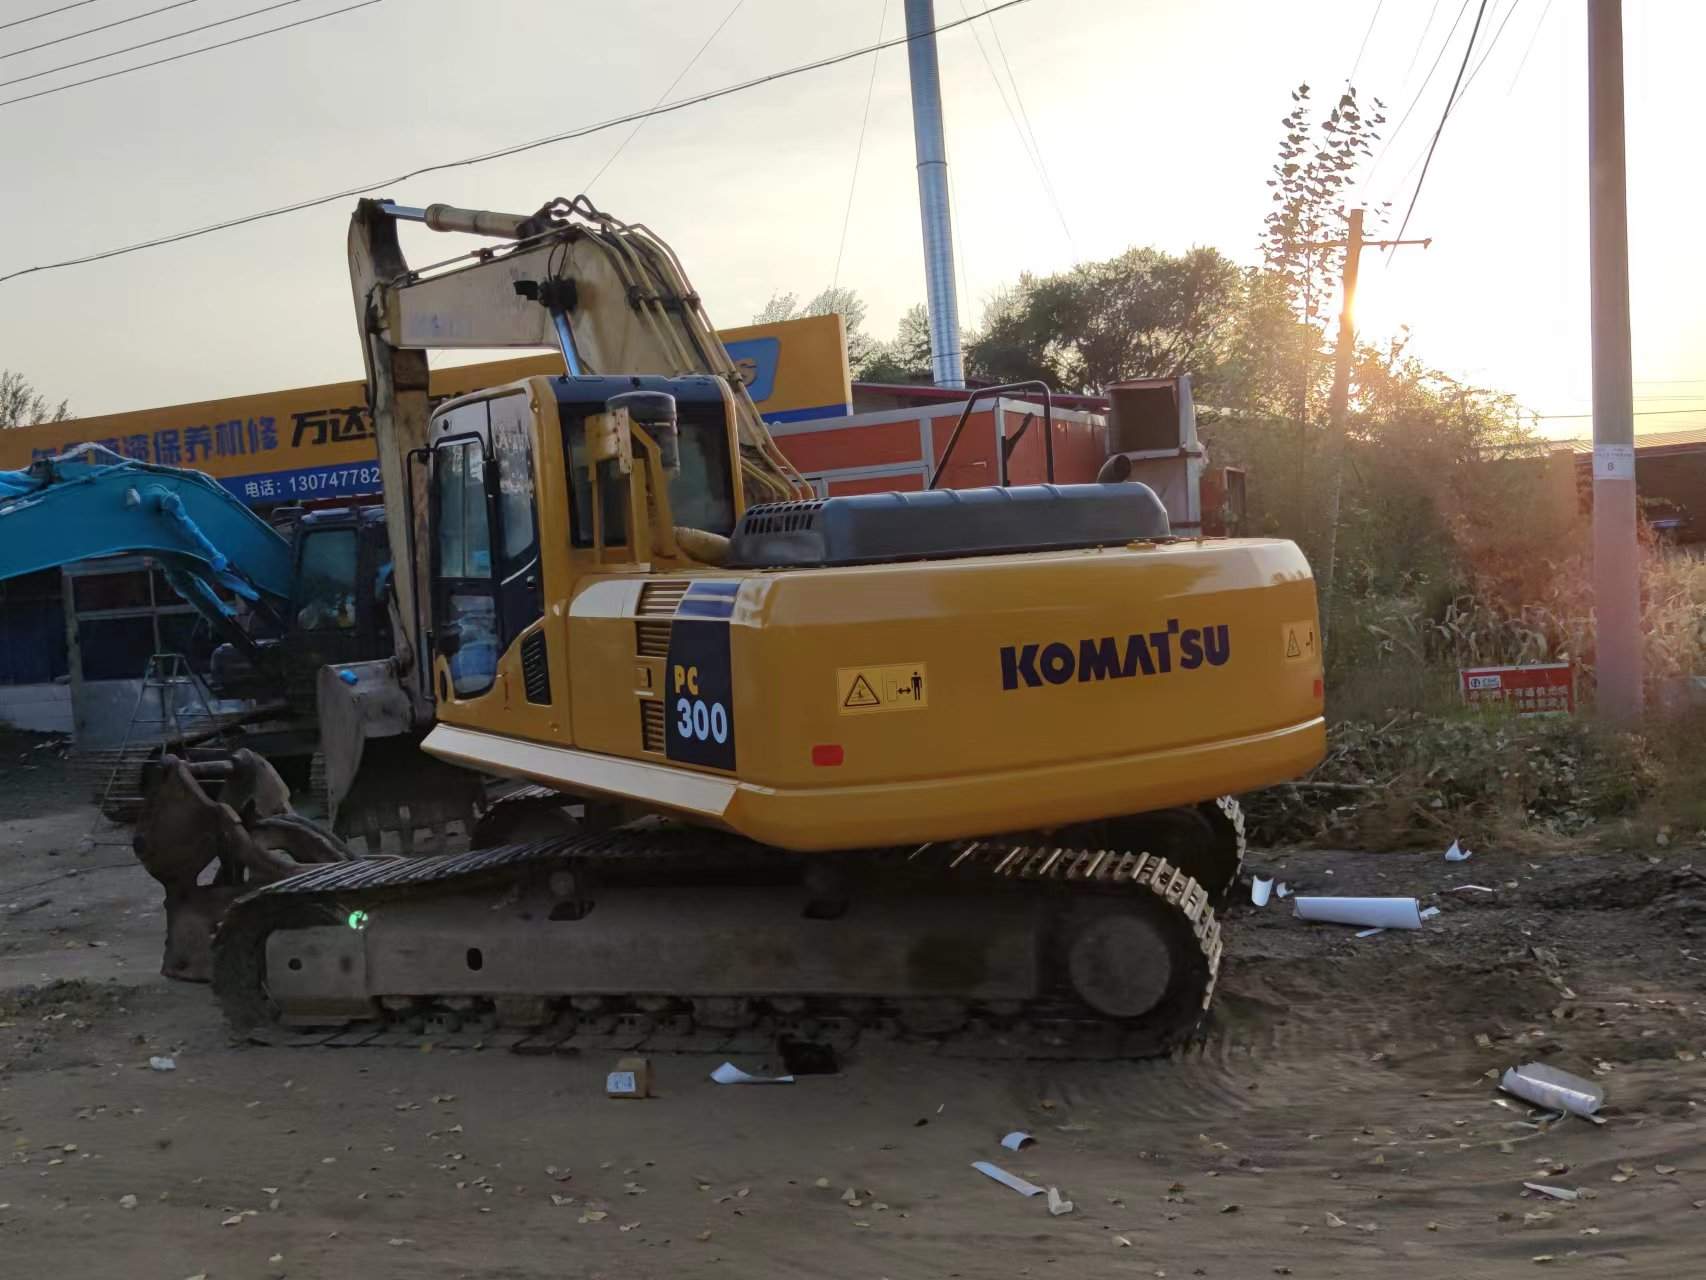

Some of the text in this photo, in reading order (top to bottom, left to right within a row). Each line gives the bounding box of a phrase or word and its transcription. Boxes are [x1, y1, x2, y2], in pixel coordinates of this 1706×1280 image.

[292, 406, 376, 447] 万达
[1000, 619, 1230, 691] KOMATSU
[673, 664, 699, 696] PC
[676, 697, 728, 744] 300
